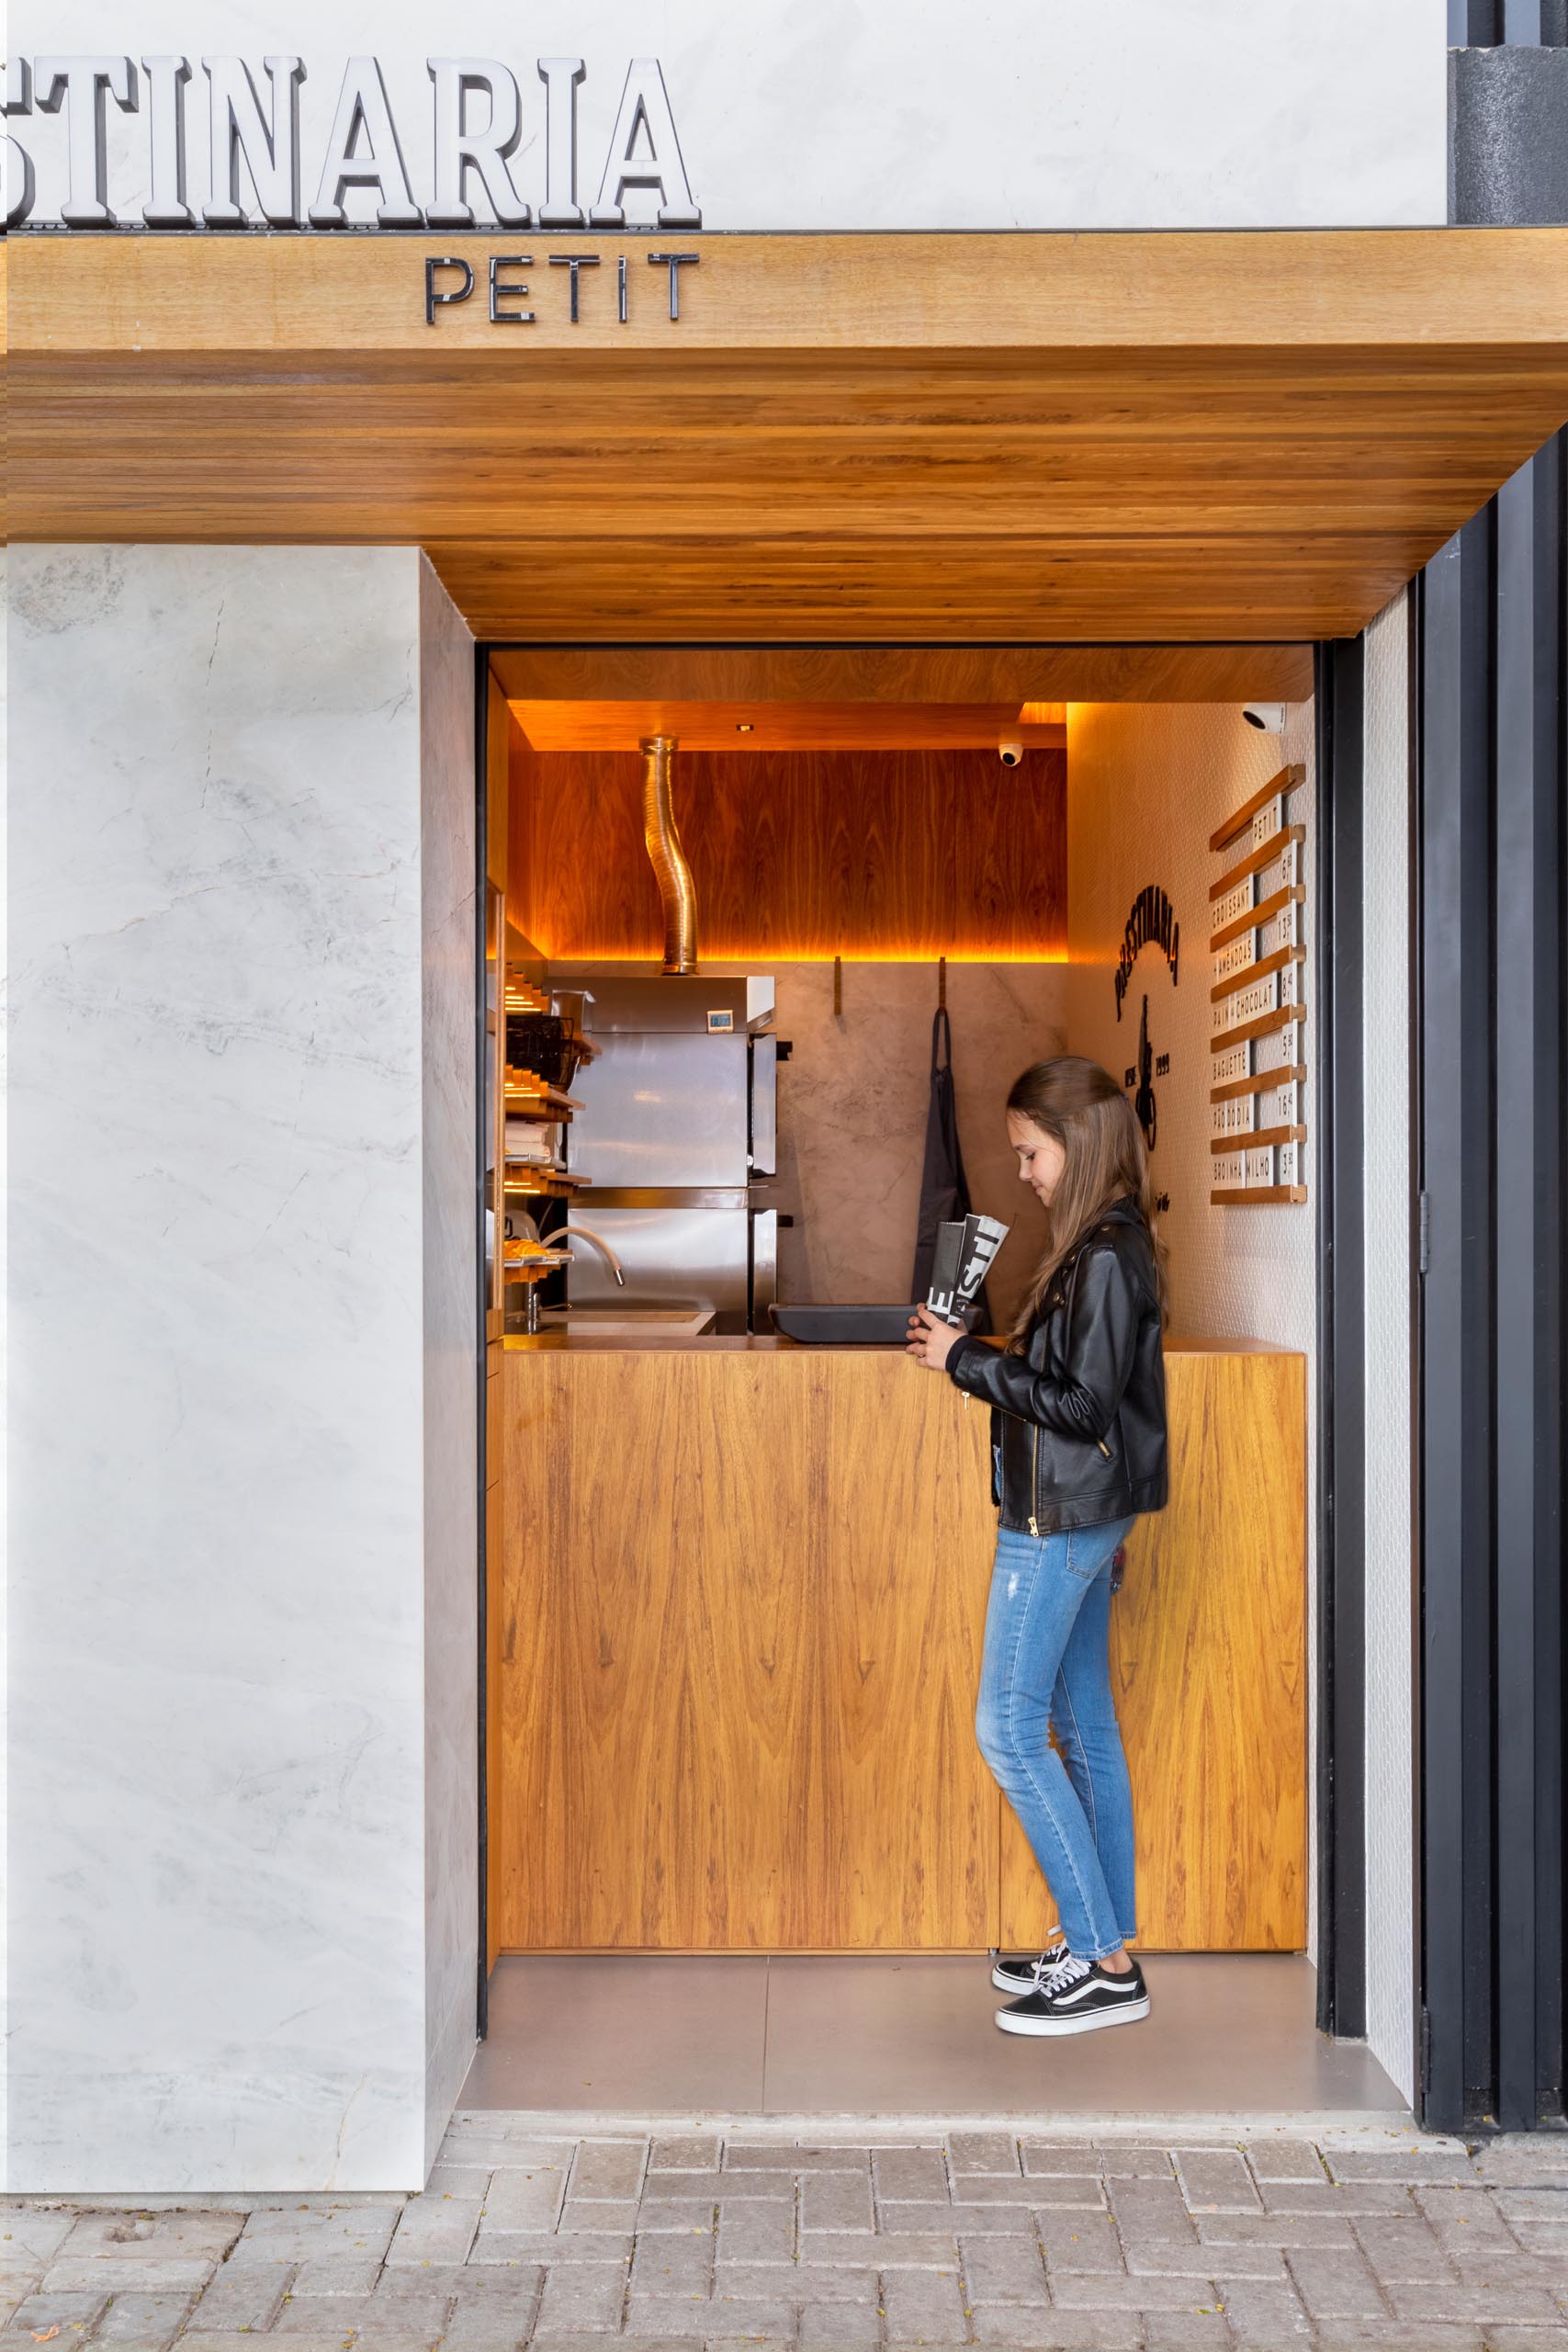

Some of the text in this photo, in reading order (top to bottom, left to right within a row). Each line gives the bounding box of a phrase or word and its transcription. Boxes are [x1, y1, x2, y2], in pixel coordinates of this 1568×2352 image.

[425, 254, 700, 324] PETIT
[1253, 806, 1278, 843] PETIT
[1213, 885, 1250, 929] CROISSANT
[1218, 939, 1252, 975] AMÊNDOAS
[1213, 1004, 1229, 1027] PAIN
[1235, 984, 1272, 1019] CHOCOLAT
[1213, 1050, 1246, 1080] BAGUETTE
[1213, 1108, 1225, 1129] PÃO
[1227, 1108, 1235, 1127] DO
[1237, 1106, 1250, 1125] DIA
[1213, 1159, 1243, 1182] BROINHA
[1246, 1157, 1269, 1179] MILHO
